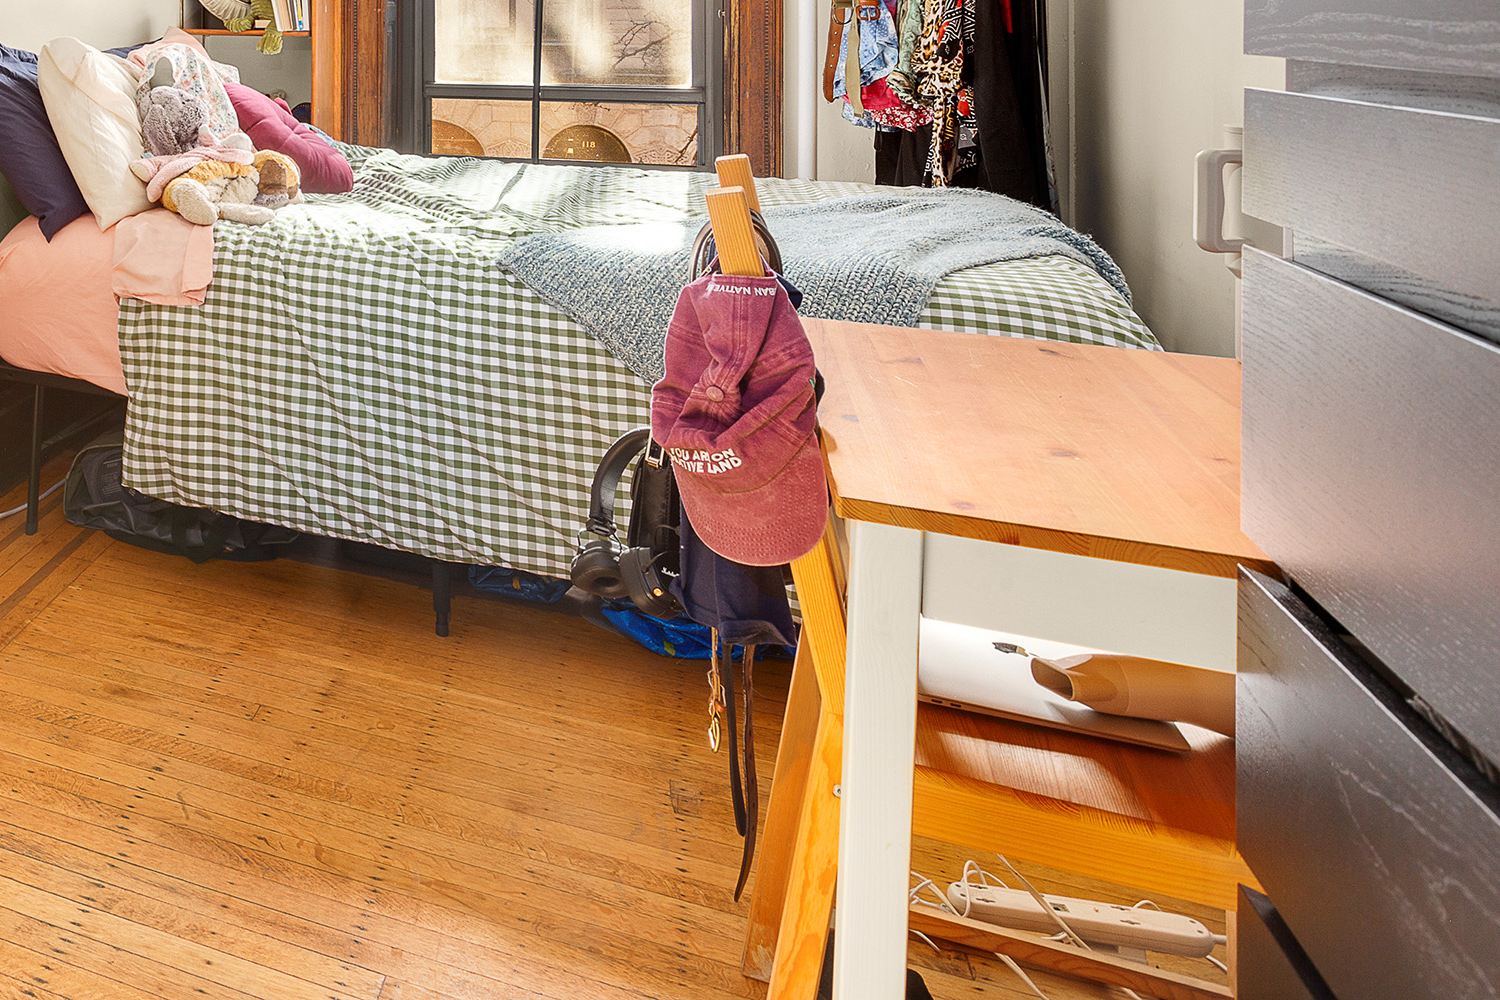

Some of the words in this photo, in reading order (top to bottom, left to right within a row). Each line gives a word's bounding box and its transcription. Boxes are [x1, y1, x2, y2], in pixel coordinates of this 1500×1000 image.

[713, 284, 752, 296] NATIVE
[711, 448, 736, 462] ON
[707, 456, 742, 475] LAND
